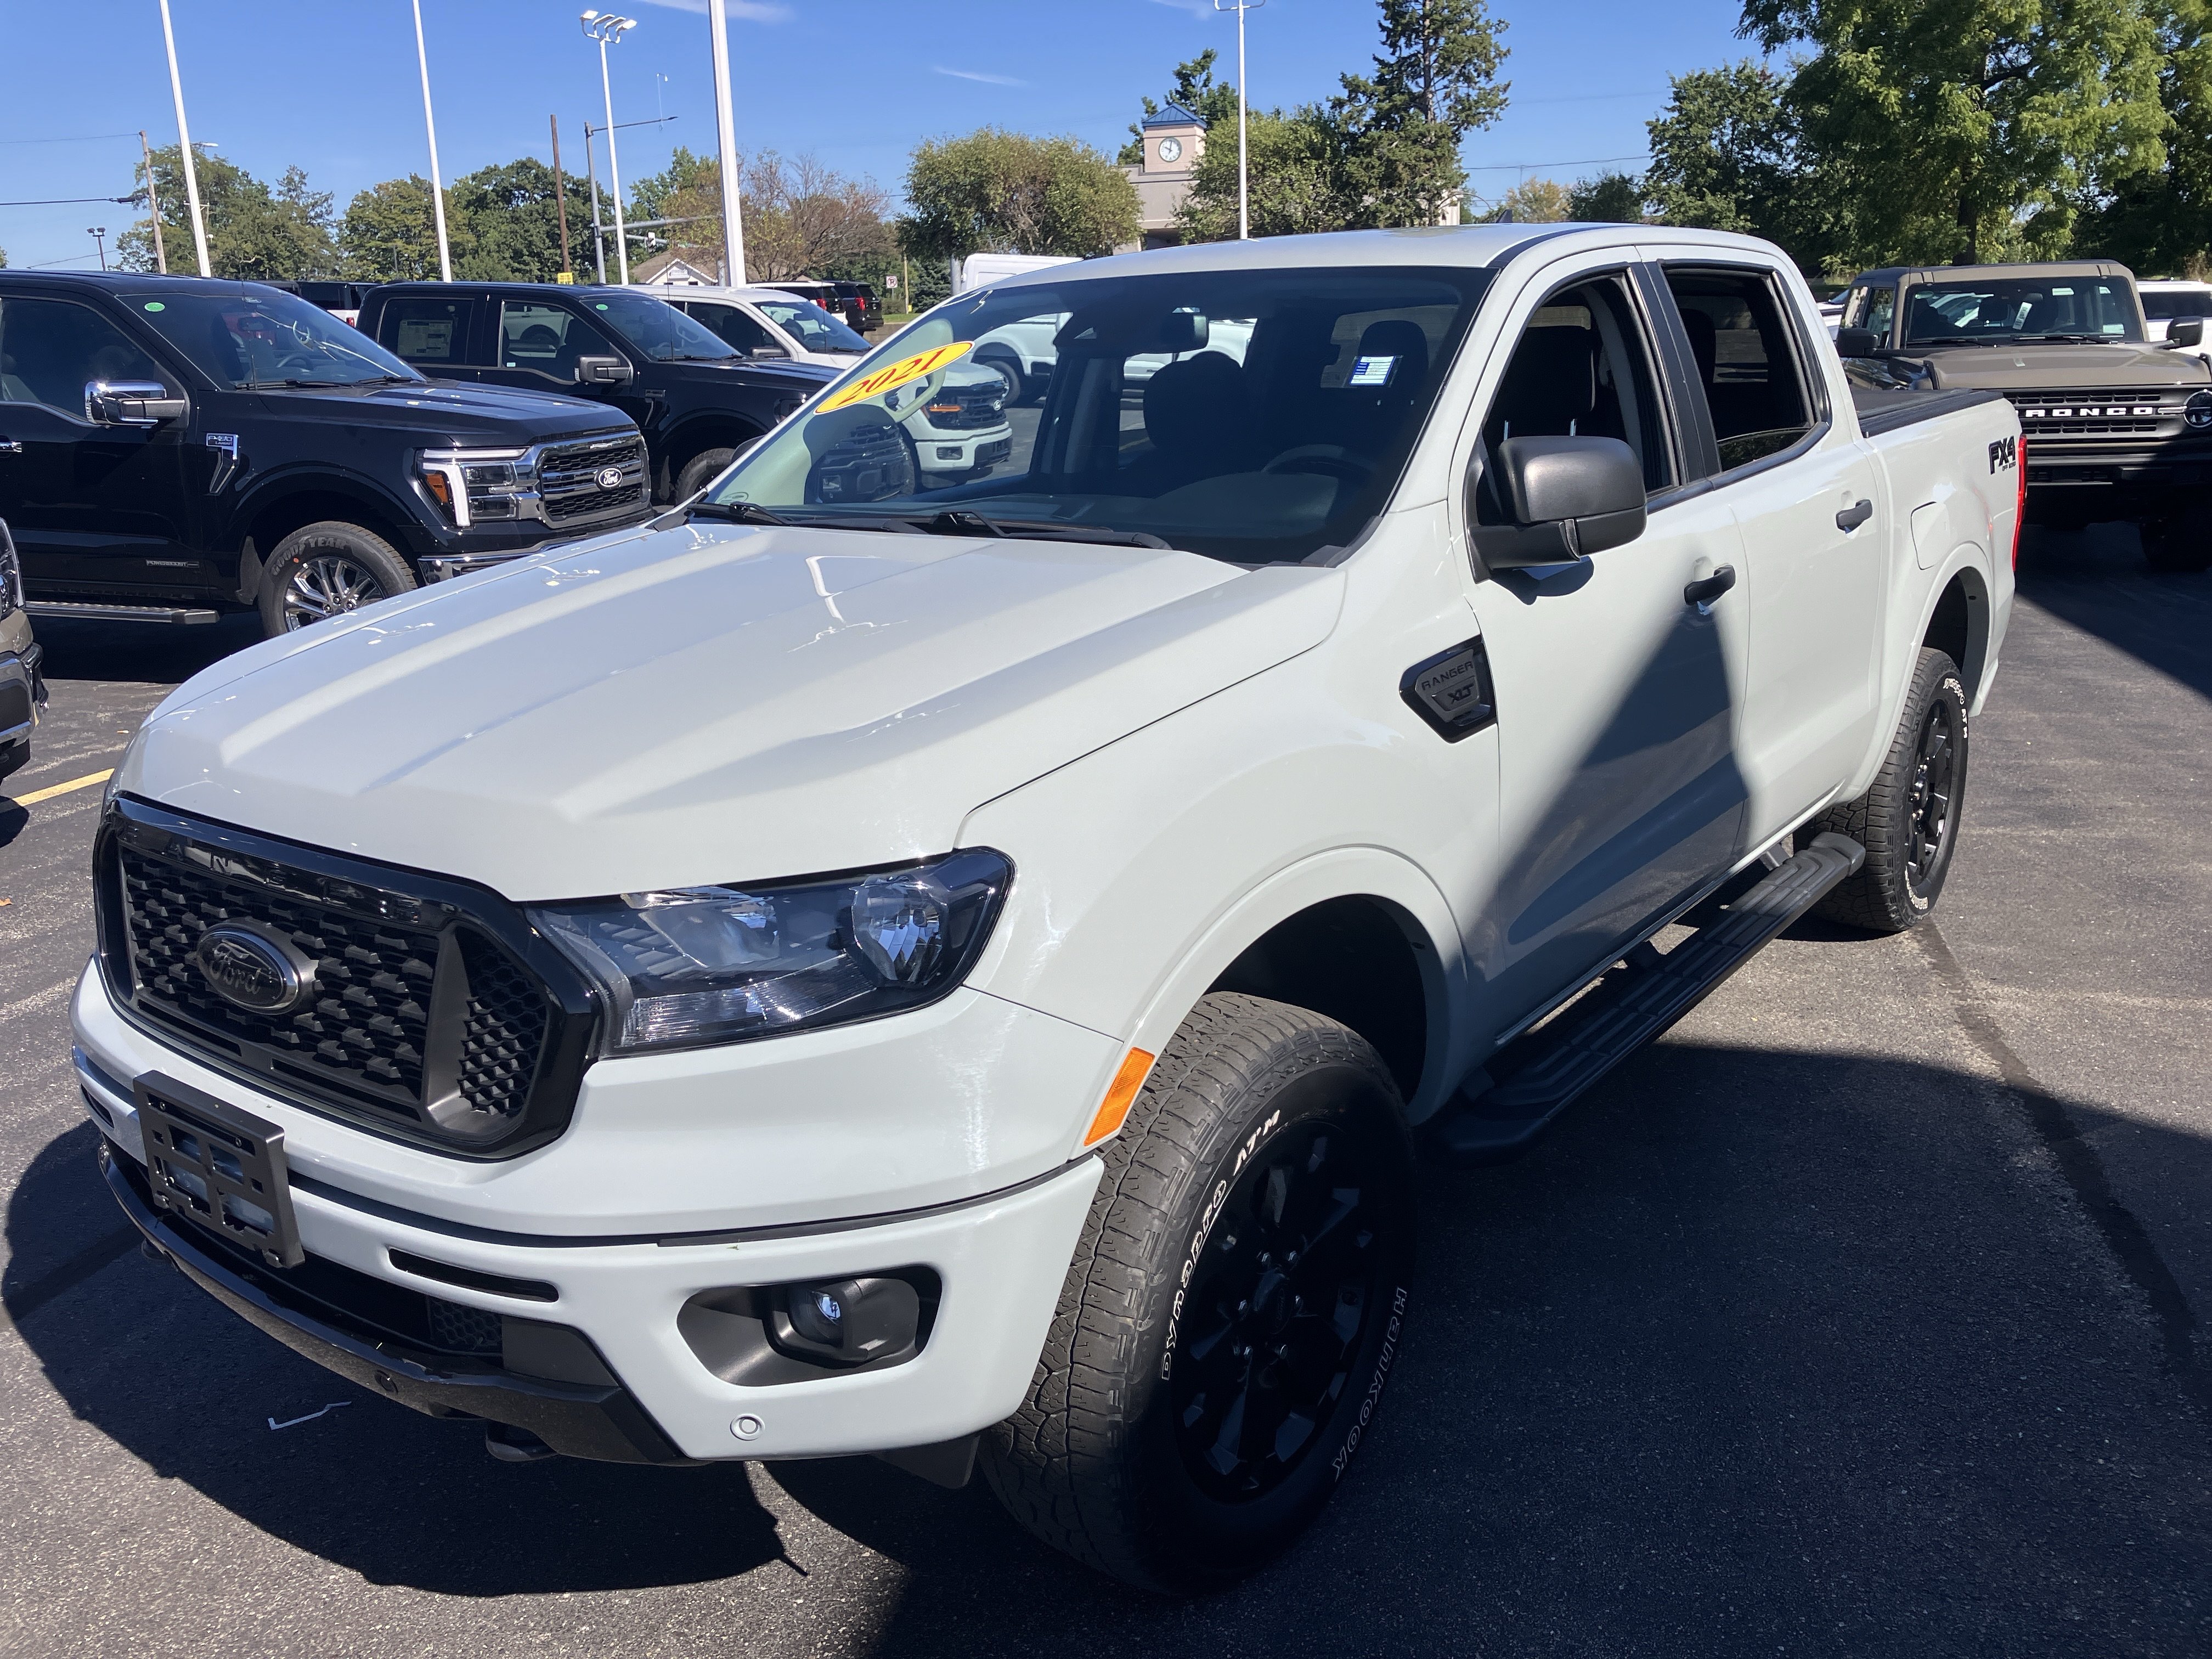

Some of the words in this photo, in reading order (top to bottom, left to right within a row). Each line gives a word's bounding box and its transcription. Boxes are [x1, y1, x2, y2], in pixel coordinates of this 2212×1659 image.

[836, 348, 947, 407] 2021
[2015, 407, 2153, 417] RONCO
[1988, 435, 2016, 475] FX4
[603, 471, 619, 484] Ford
[271, 535, 349, 577] GOODYEAR
[1421, 661, 1474, 691] RANGER
[1447, 682, 1474, 705] XLT
[208, 942, 261, 995] Ford
